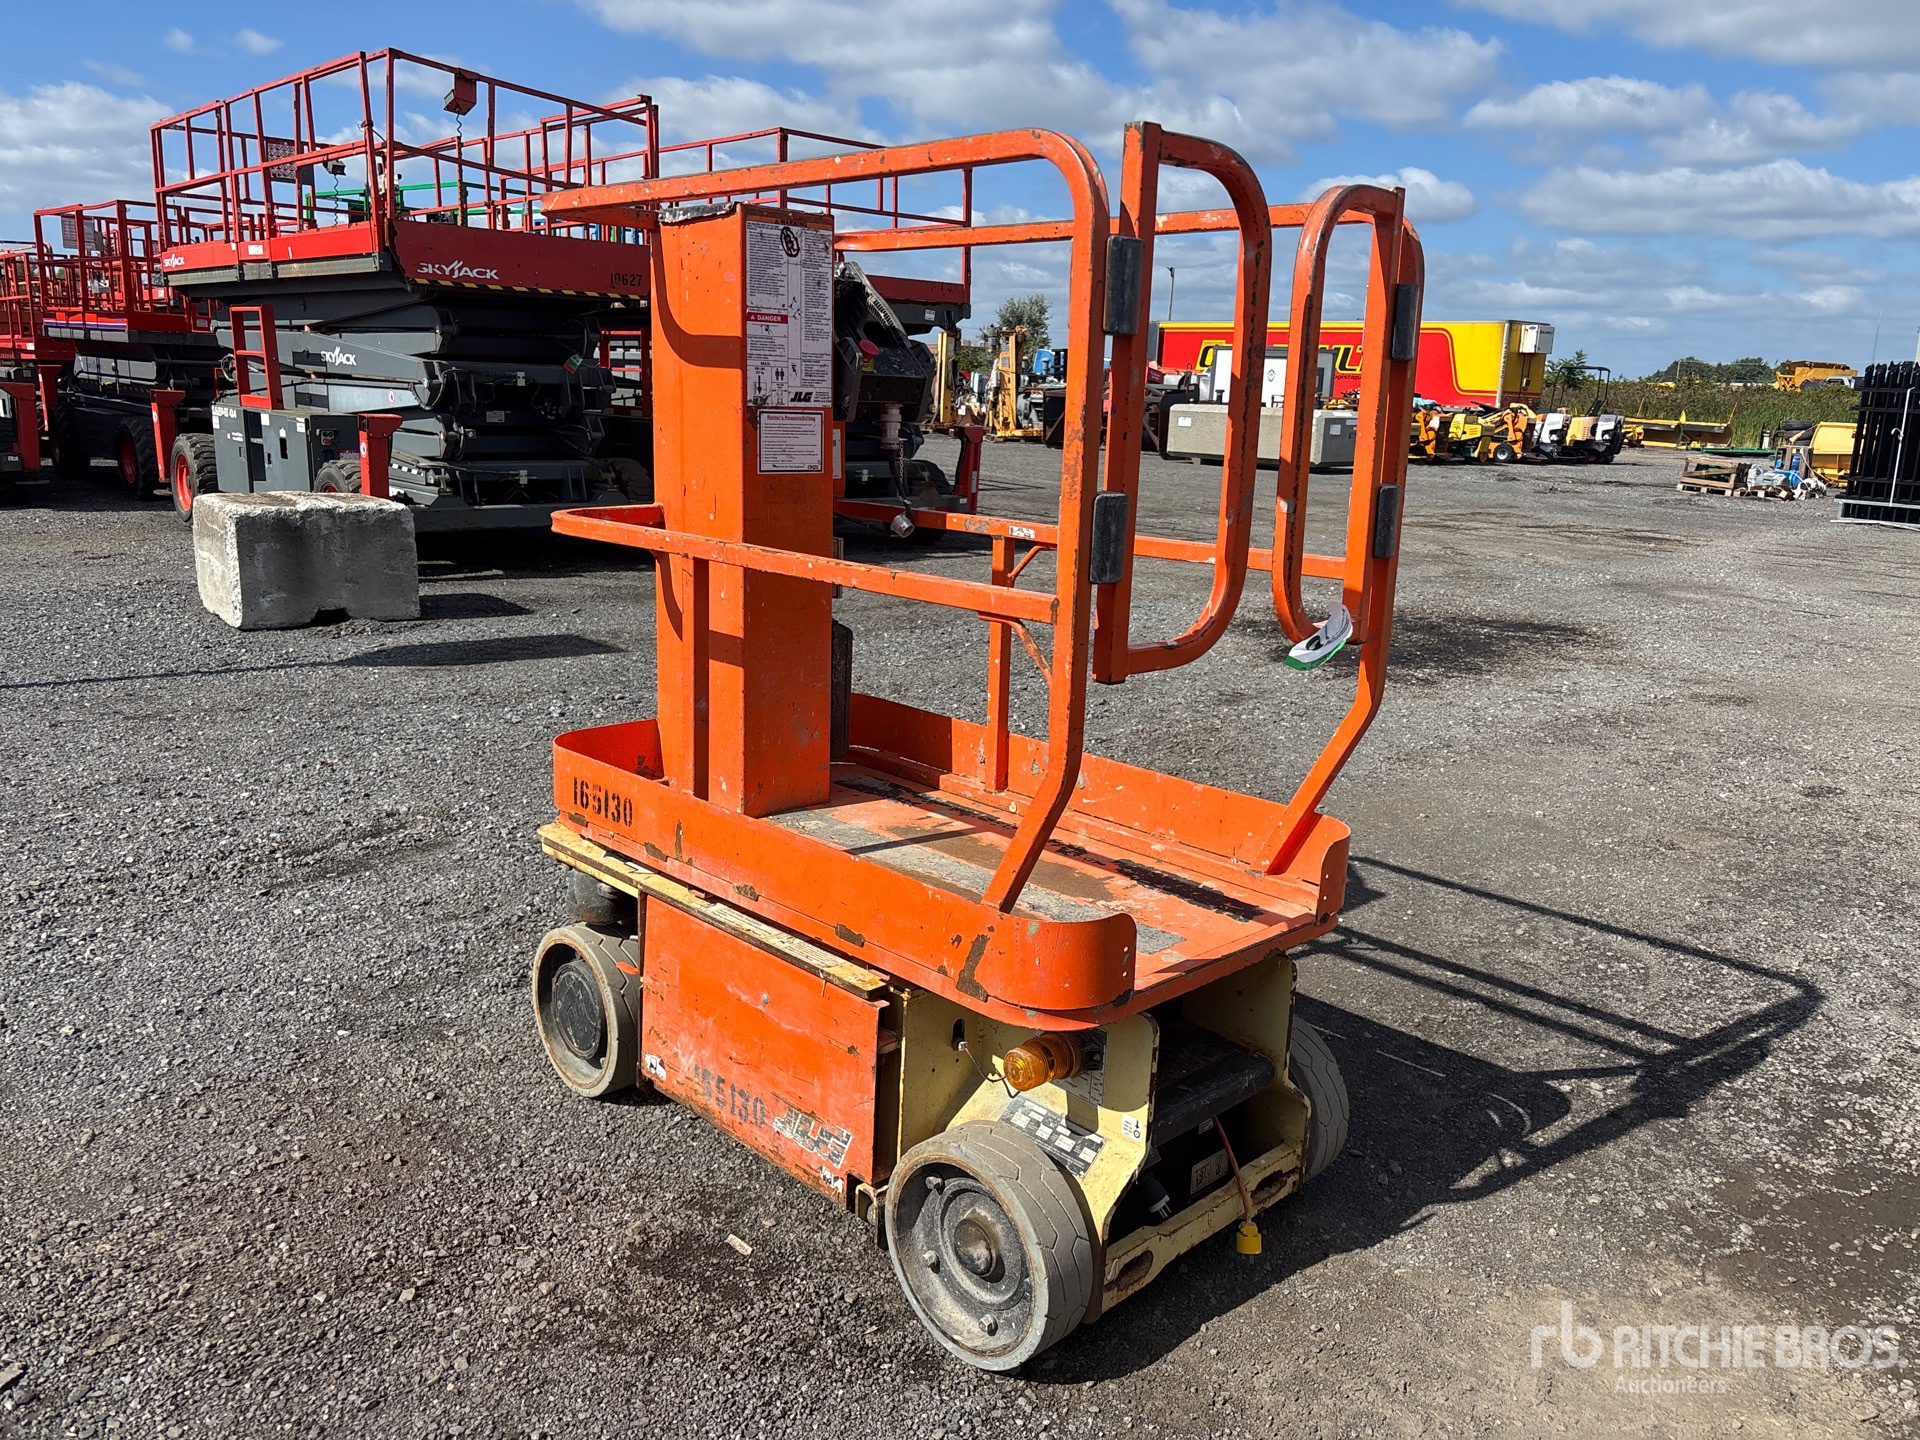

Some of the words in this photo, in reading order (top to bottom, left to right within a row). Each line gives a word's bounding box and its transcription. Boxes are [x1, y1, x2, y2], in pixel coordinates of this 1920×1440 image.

[416, 259, 500, 280] SKYJACK
[757, 314, 782, 322] DANGER
[320, 346, 357, 366] SKYJACK
[790, 391, 813, 403] JLG
[573, 776, 633, 827] 165130
